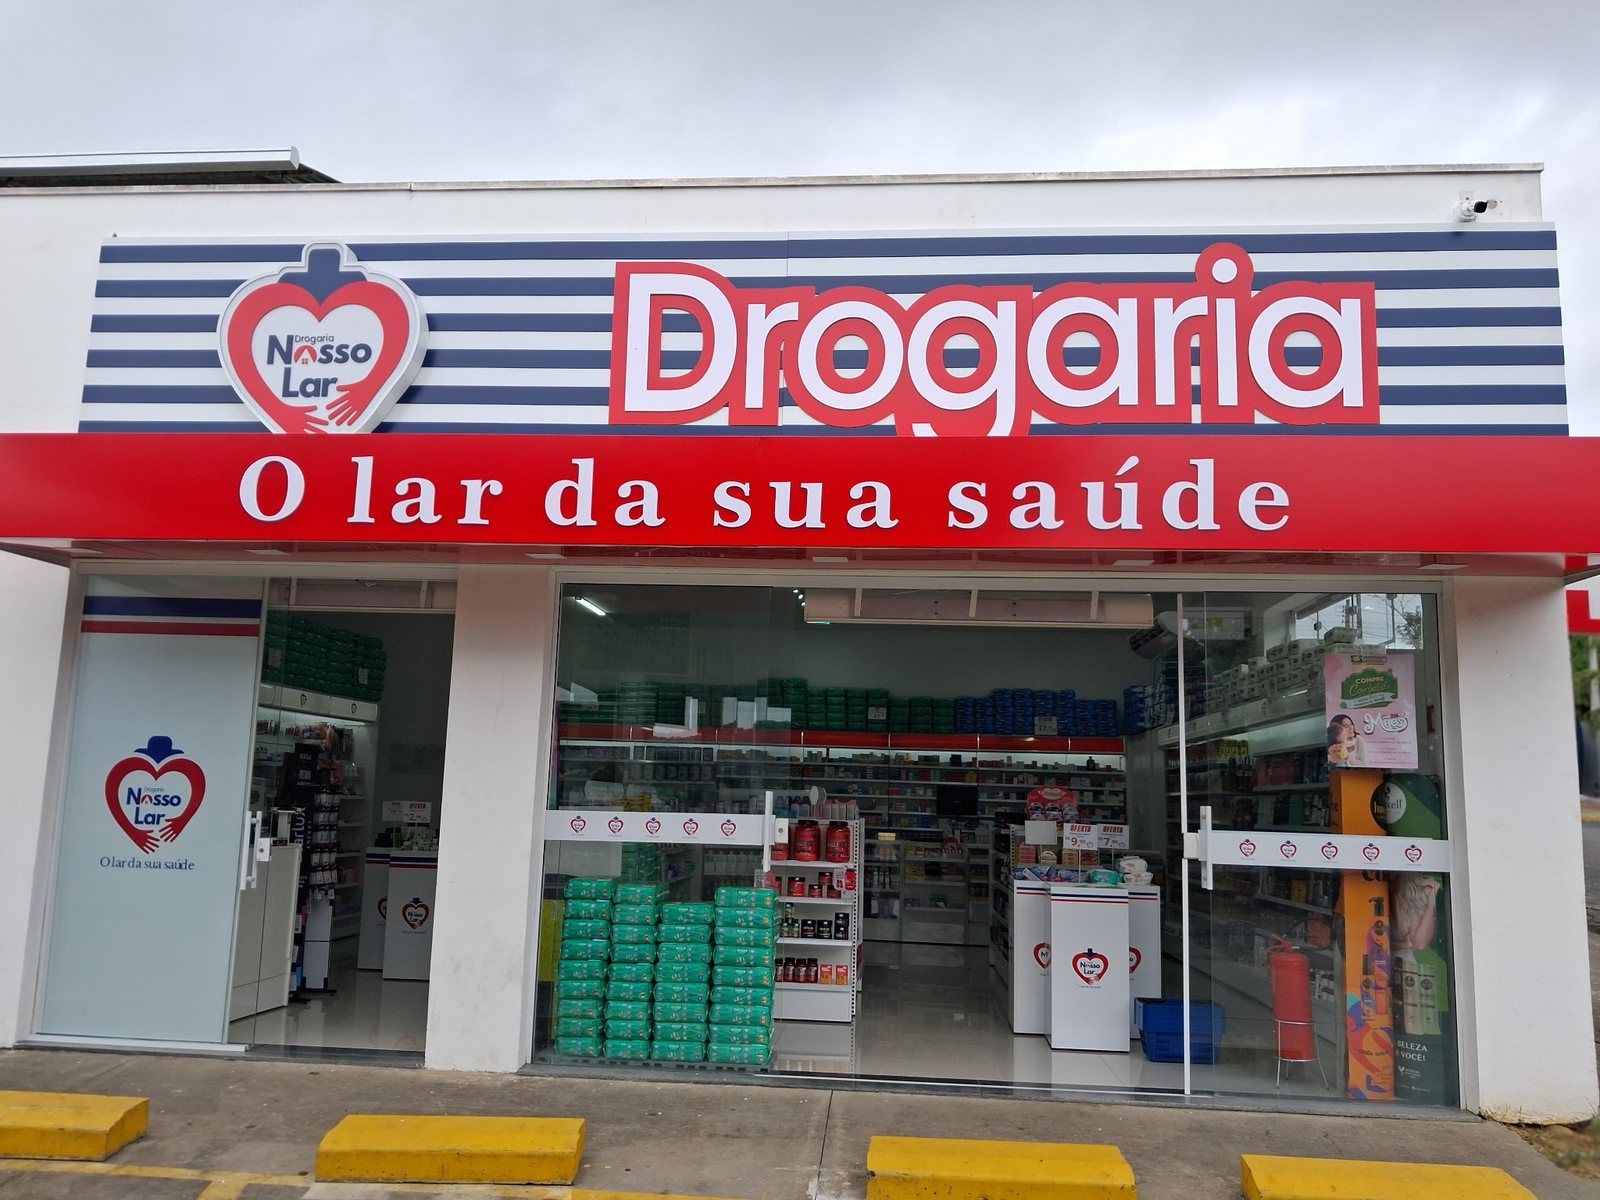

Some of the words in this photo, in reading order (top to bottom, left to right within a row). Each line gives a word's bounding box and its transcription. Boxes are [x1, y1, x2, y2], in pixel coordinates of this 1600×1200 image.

[294, 333, 335, 345] Drogaria
[622, 256, 1363, 438] Drogaria
[266, 334, 373, 365] Nosso
[281, 366, 339, 398] Lar
[239, 455, 306, 523] O
[346, 456, 504, 526] lar
[543, 458, 667, 528] da
[712, 480, 899, 530] sua
[947, 455, 1291, 532] saúde
[126, 787, 182, 806] Nosso
[134, 806, 166, 825] Lar
[99, 856, 111, 868] O
[111, 856, 127, 868] lar
[127, 857, 142, 869] da
[144, 860, 161, 870] sua
[163, 859, 195, 871] saúde
[1397, 1040, 1428, 1053] BELEZA
